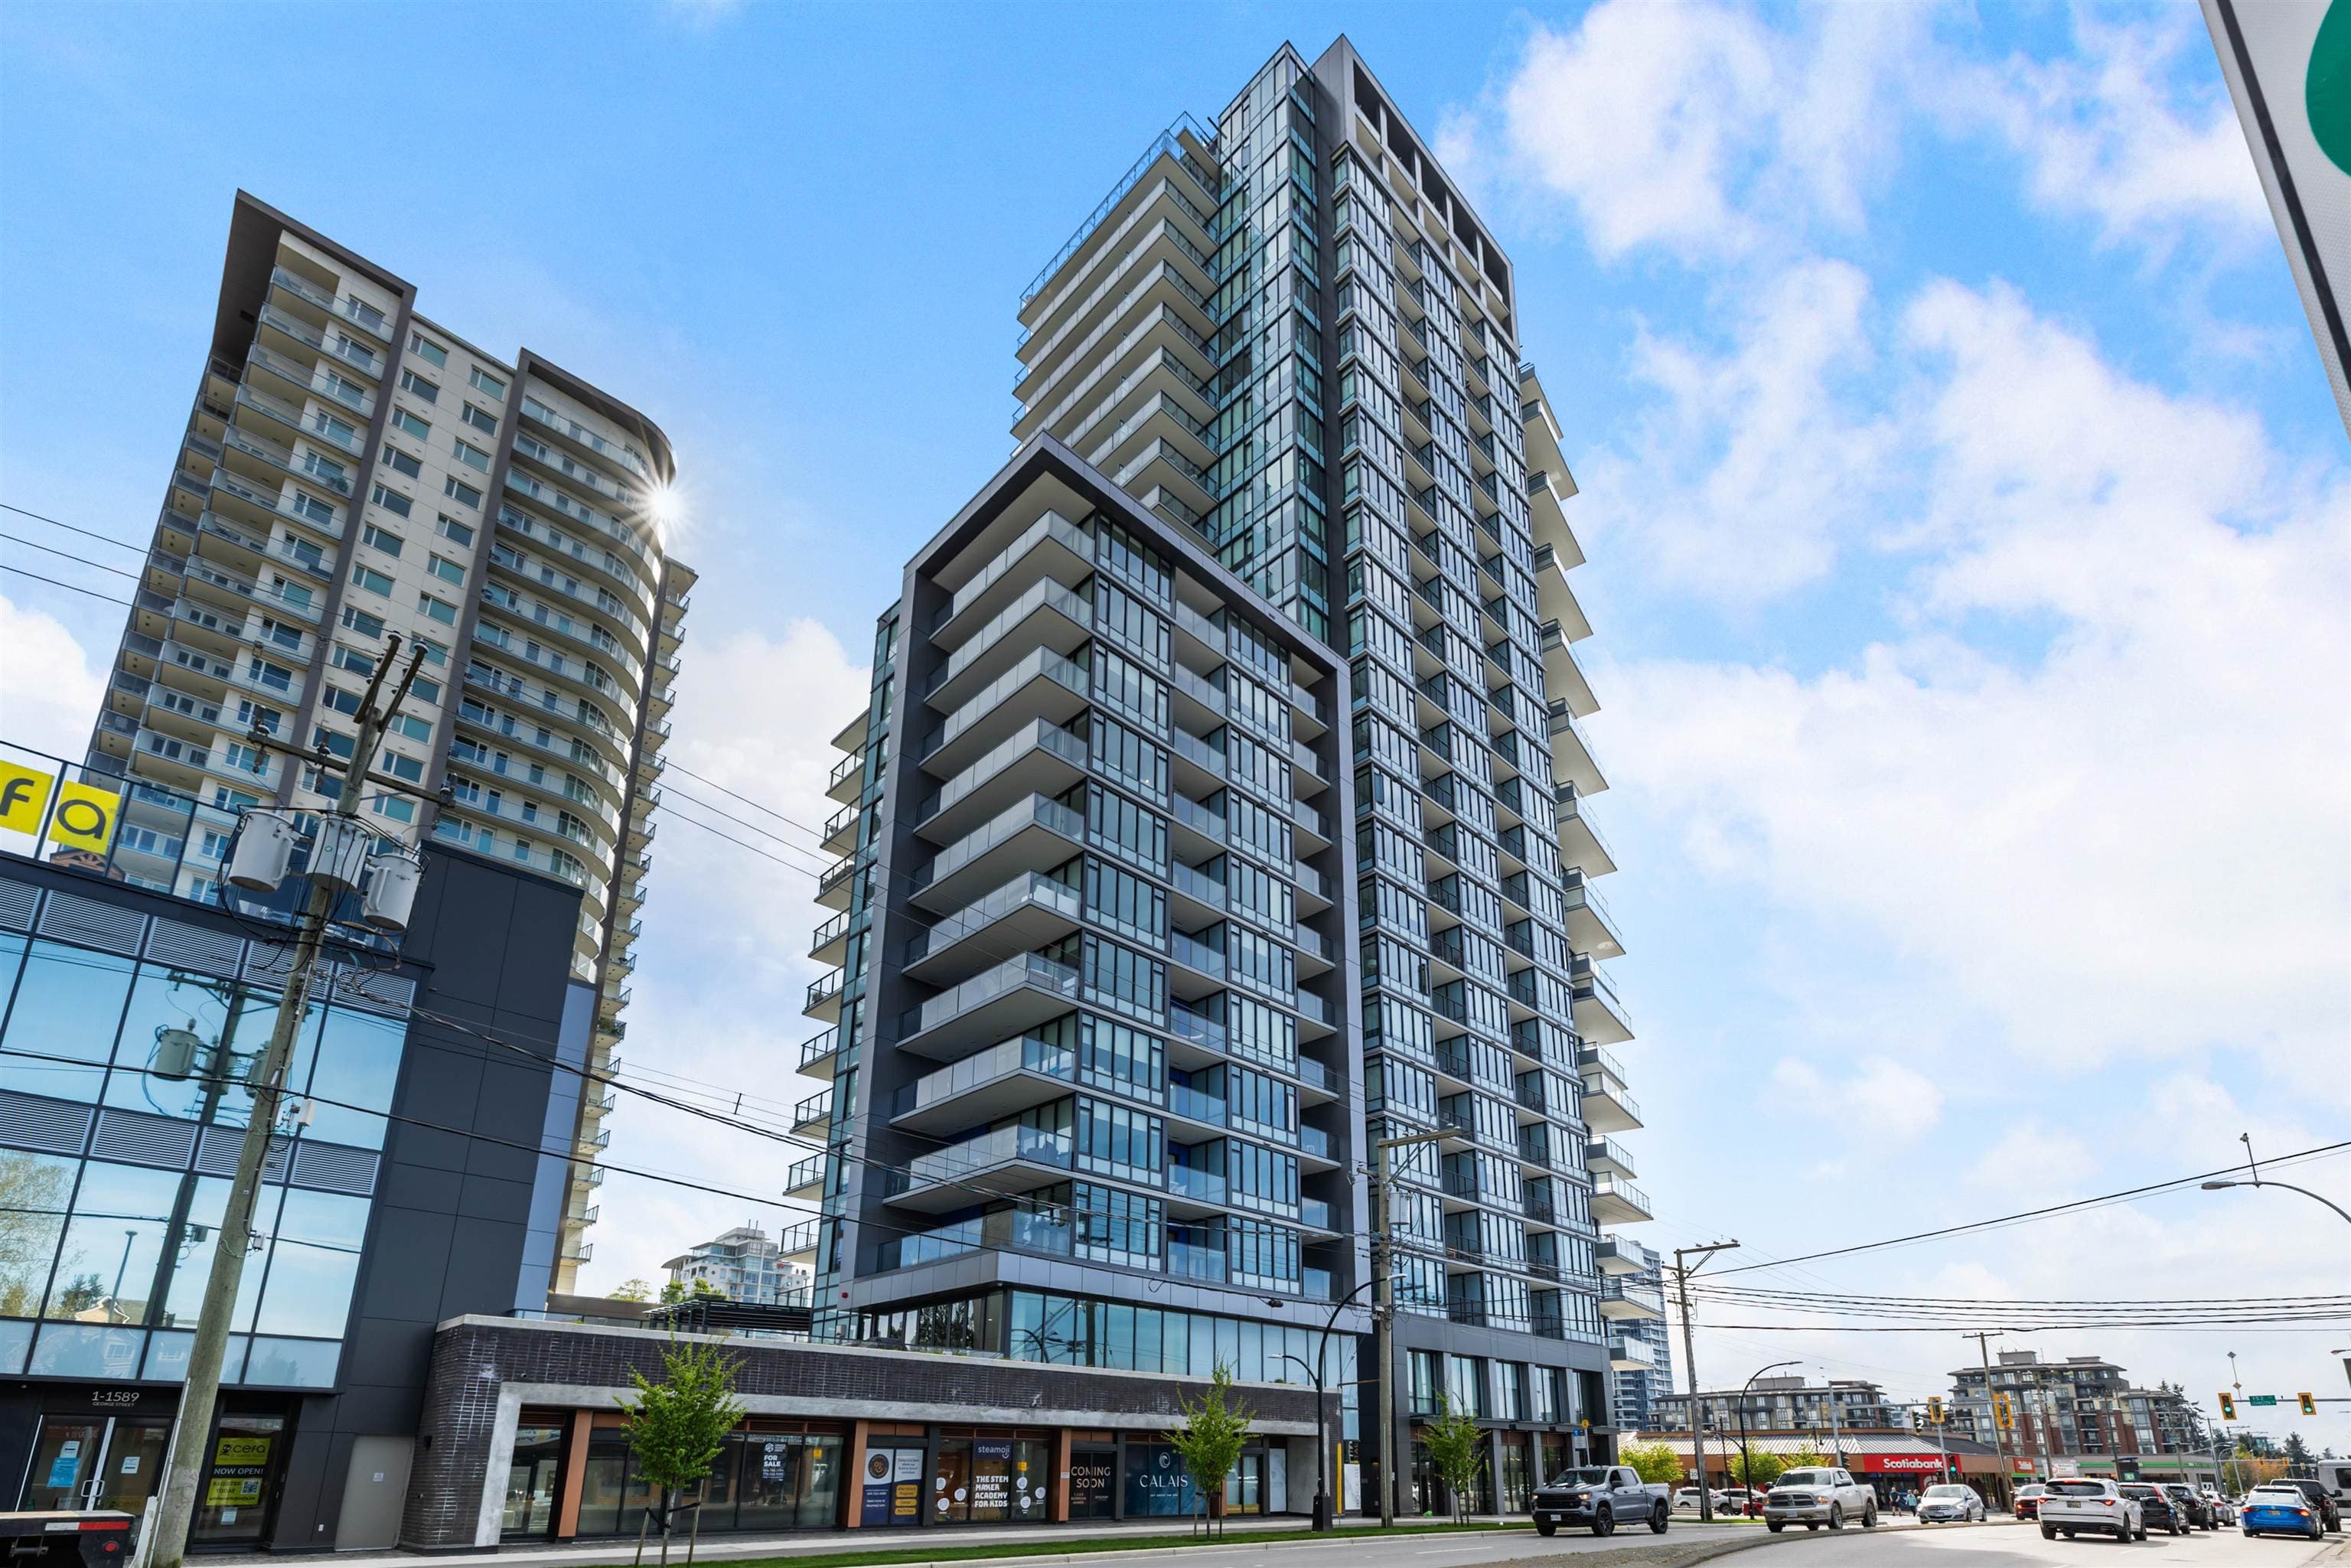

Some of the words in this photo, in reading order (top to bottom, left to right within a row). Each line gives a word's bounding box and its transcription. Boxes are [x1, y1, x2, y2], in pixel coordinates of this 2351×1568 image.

[91, 1391, 140, 1403] 1-1589
[233, 1445, 266, 1453] cefa
[977, 1445, 1011, 1459] steamoji
[1883, 1459, 1944, 1469] Scotiabank
[1071, 1466, 1111, 1476] COMING
[1076, 1478, 1105, 1488] SOON
[1139, 1475, 1189, 1488] CALAIS
